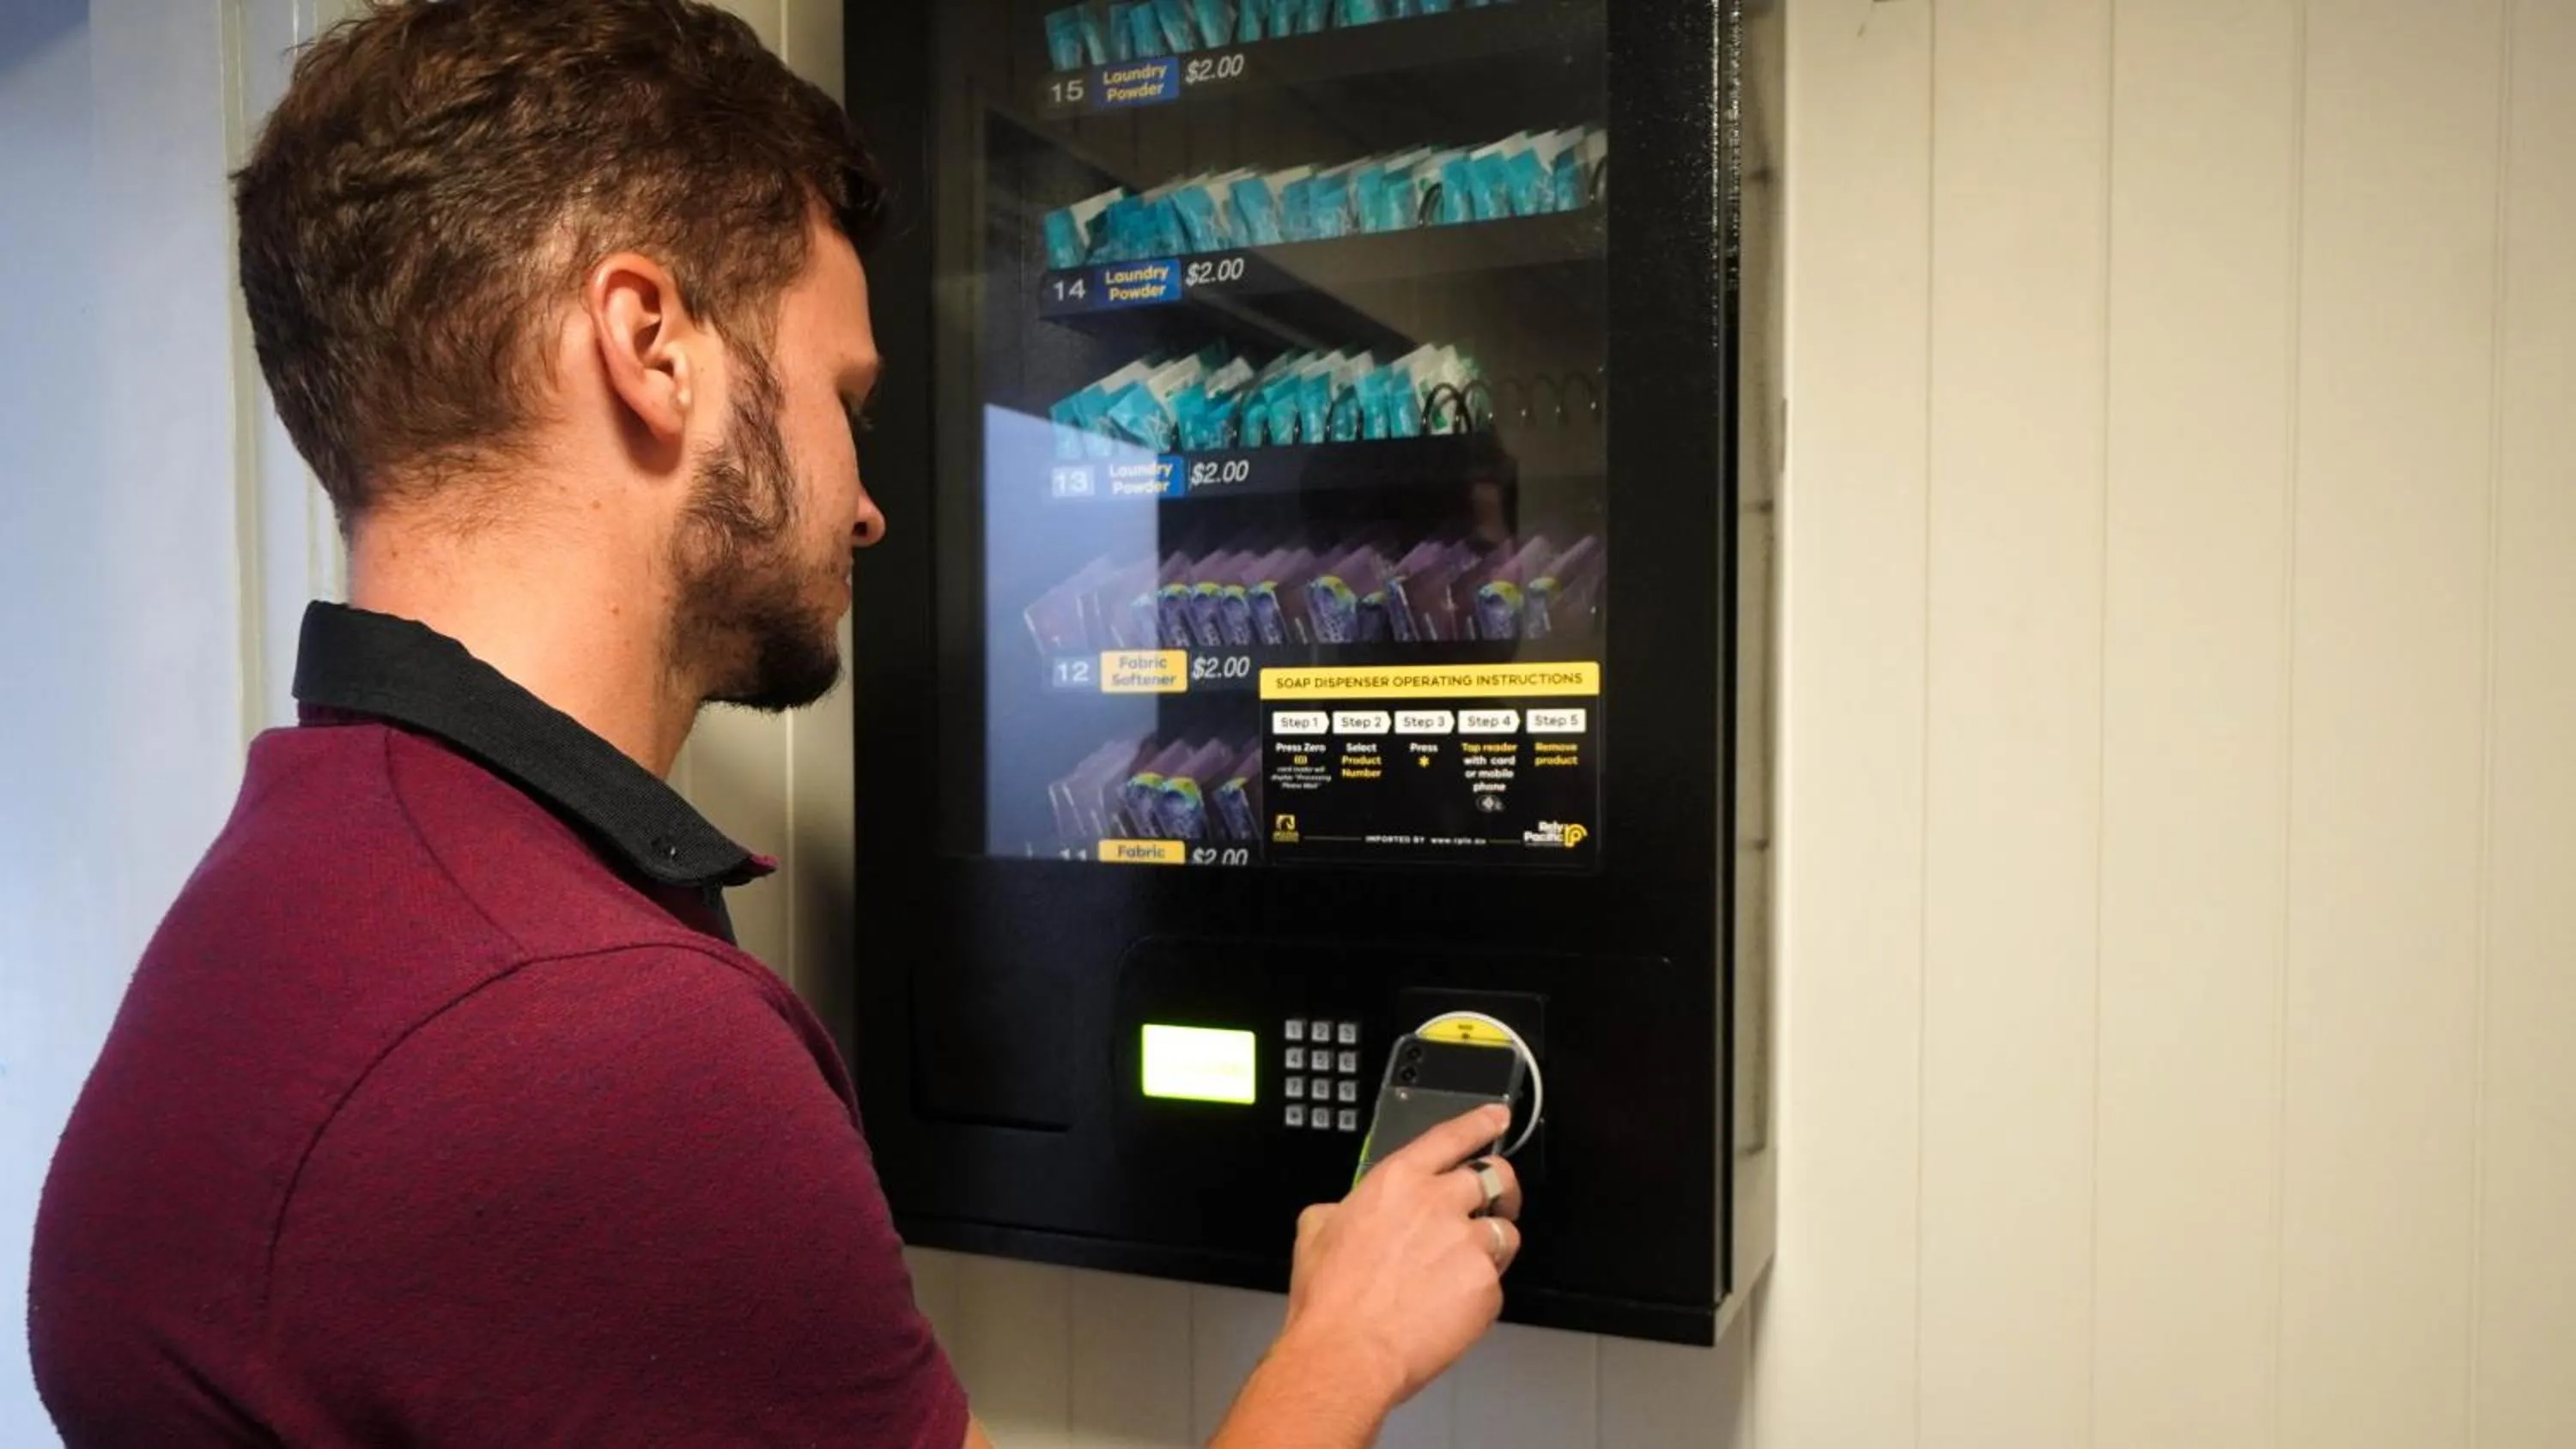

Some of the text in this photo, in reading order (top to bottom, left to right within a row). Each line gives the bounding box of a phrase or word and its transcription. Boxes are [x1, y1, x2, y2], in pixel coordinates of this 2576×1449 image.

[1103, 64, 1168, 85] Laundry
[1185, 53, 1244, 84] $2.00
[1051, 80, 1084, 102] 15
[1107, 82, 1164, 102] Powder
[1105, 264, 1170, 286] Laundry
[1185, 258, 1244, 287] $2.00
[1054, 279, 1086, 301] 14
[1109, 282, 1166, 301] Powder
[1109, 462, 1173, 479] Laundry
[1191, 460, 1249, 486] $2.00
[1056, 470, 1088, 493] 13
[1113, 478, 1170, 495] Powder
[1119, 655, 1167, 670] Fabric
[1192, 656, 1250, 680] $2.00
[1057, 660, 1089, 682] 12
[1112, 672, 1176, 686] Softener
[1275, 672, 1583, 689] SOAP DISPENSER OPERATING INSTRUCTIONS
[1281, 718, 1318, 728] Step 1
[1341, 717, 1382, 728] Step 2
[1404, 716, 1445, 728] Step 3
[1467, 716, 1511, 728] Step 4
[1534, 714, 1579, 727] Step 5
[1275, 743, 1326, 753] Press Zero
[1346, 743, 1377, 753] Select
[1410, 743, 1438, 753] Press
[1461, 743, 1518, 753] Tap reader
[1534, 742, 1578, 753] Remove
[1342, 755, 1382, 765] Product
[1463, 755, 1516, 766] with card
[1534, 755, 1578, 767] product
[1342, 768, 1382, 778] Number
[1465, 768, 1515, 779] or mobile
[1473, 782, 1506, 793] phone
[1413, 835, 1425, 844] BY
[1523, 830, 1564, 842] Pacific
[1117, 845, 1165, 859] Fabric
[1192, 847, 1249, 865] $200
